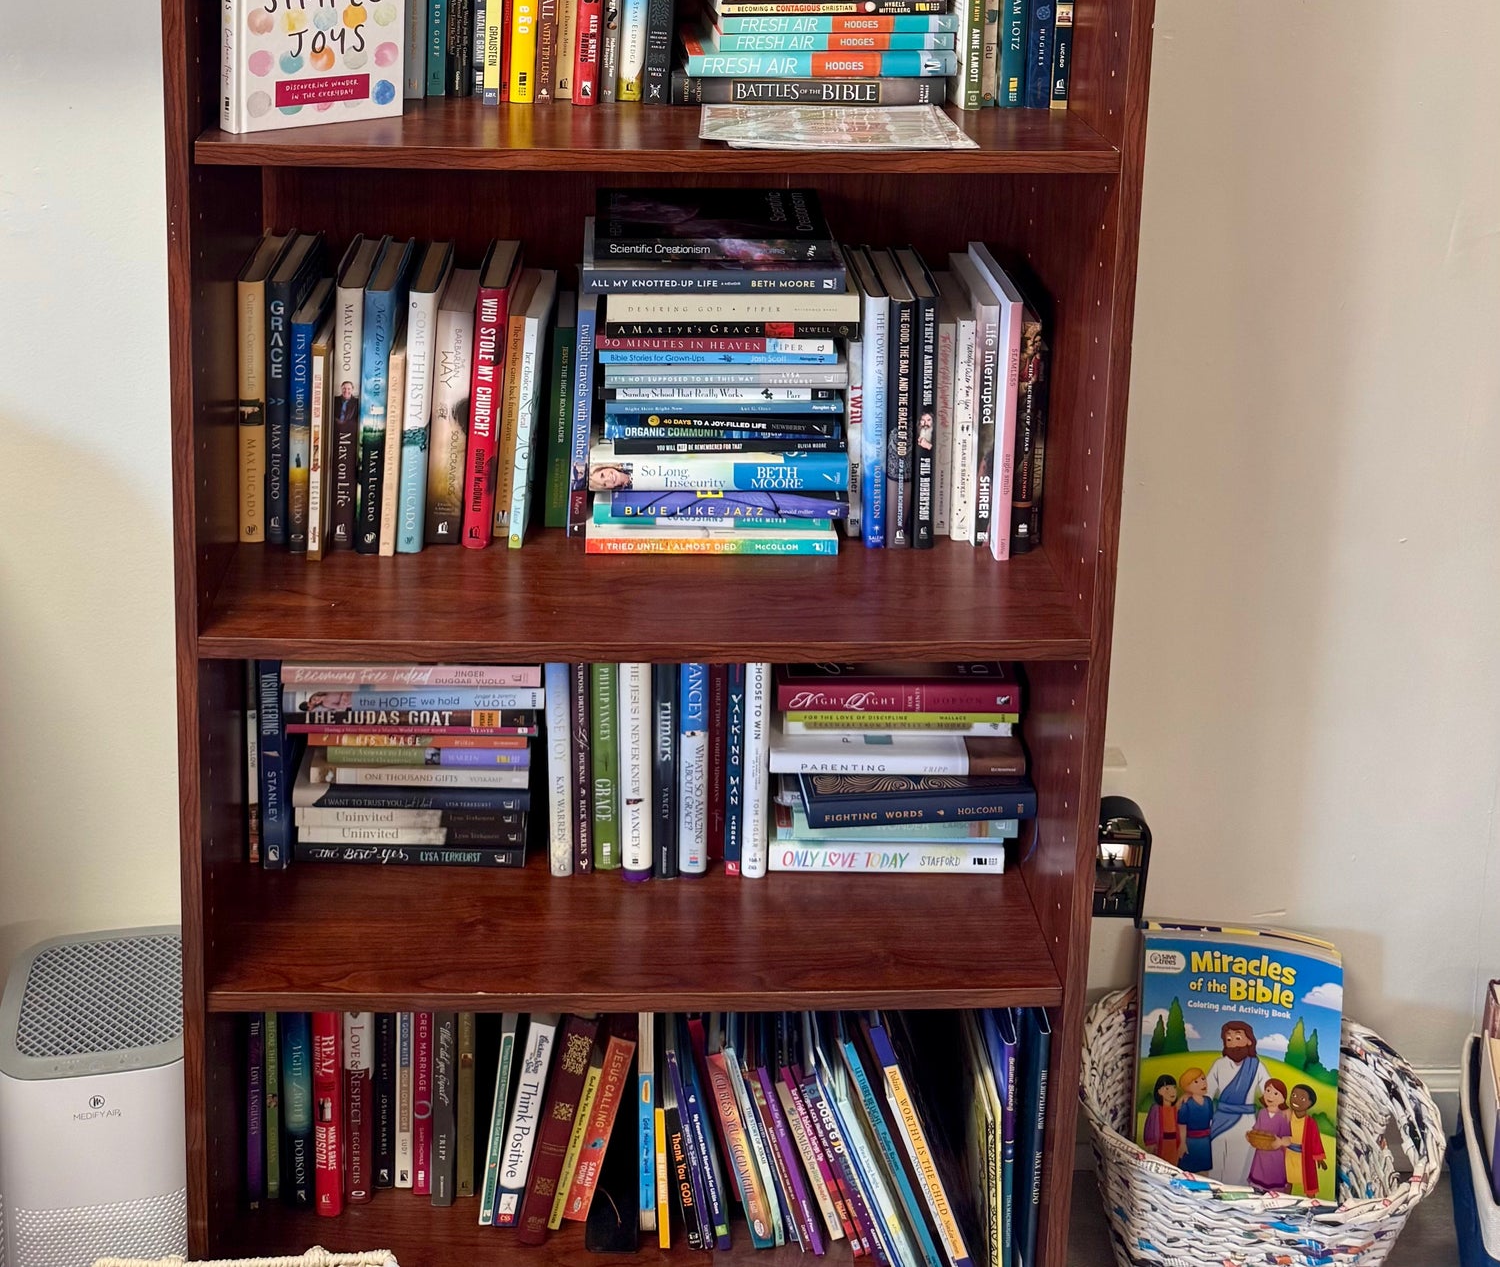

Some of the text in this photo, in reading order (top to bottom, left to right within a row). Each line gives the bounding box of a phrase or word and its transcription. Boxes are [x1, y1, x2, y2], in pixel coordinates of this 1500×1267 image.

[1011, 20, 1020, 49] LOTZ
[970, 28, 980, 83] ANNE LAMOTT
[701, 58, 864, 74] FRESH AIR HODGES
[737, 83, 799, 99] BATTLES
[823, 85, 876, 100] BIBLE
[610, 244, 710, 254] Scientific Creationism
[632, 280, 693, 288] KNOTTED-UP
[752, 280, 776, 288] BETH
[779, 280, 815, 288] MOORE
[627, 341, 683, 349] MINUTES
[691, 341, 704, 349] IN
[711, 342, 760, 351] HEAVEN
[474, 298, 497, 438] WHO STOLE MY CHURCH?
[978, 323, 996, 519] Life Interrupted SHIRER
[757, 467, 798, 478] BETH
[751, 478, 803, 489] MOORE
[624, 506, 764, 515] BLUE LIKE JAZZ
[342, 711, 452, 726] JUDAS GOAT
[801, 764, 886, 772] PARENTING
[267, 770, 278, 822] STANLEY
[825, 806, 1003, 822] FIGHTING WORDS HOLCOMB
[782, 851, 818, 867] ONLY
[865, 852, 909, 868] TODAY
[920, 856, 960, 867] STAFFORD
[1191, 951, 1297, 986] Miracles
[1189, 977, 1294, 1009] of the Bible
[1187, 1000, 1291, 1019] Coloring and Activity Book
[73, 1110, 106, 1120] MEDIFY
[505, 1080, 539, 1178] Think Positive
